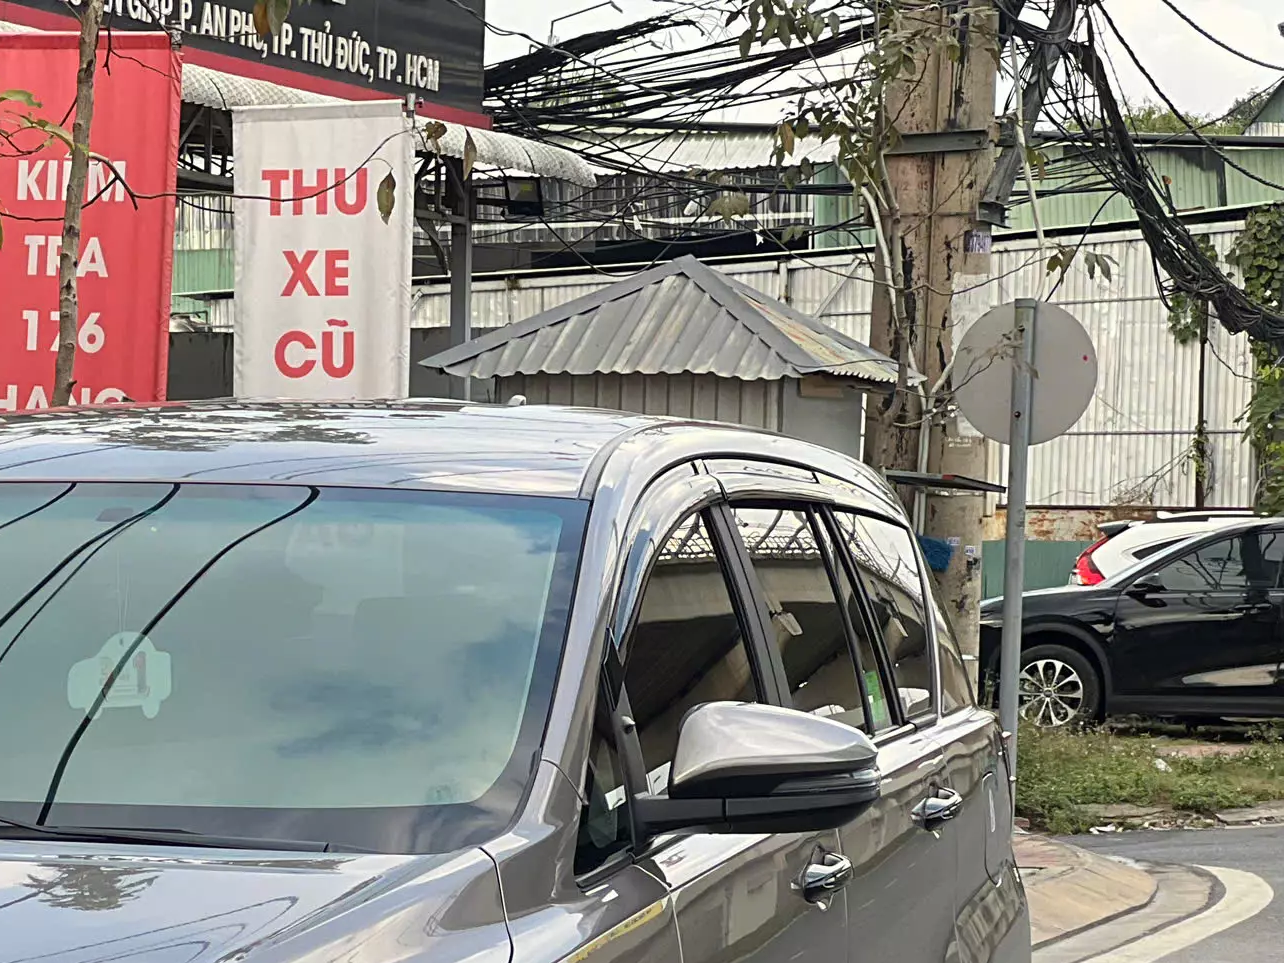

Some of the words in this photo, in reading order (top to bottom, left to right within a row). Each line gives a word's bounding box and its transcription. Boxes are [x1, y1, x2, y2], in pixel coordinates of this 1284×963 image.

[200, 2, 226, 40] AN
[299, 20, 333, 68] THỦ
[335, 30, 374, 83] ĐỨC,
[376, 46, 402, 83] TP.
[405, 53, 440, 92] HCM
[262, 168, 368, 217] THU
[281, 250, 350, 297] XE
[274, 320, 355, 378] CŨ
